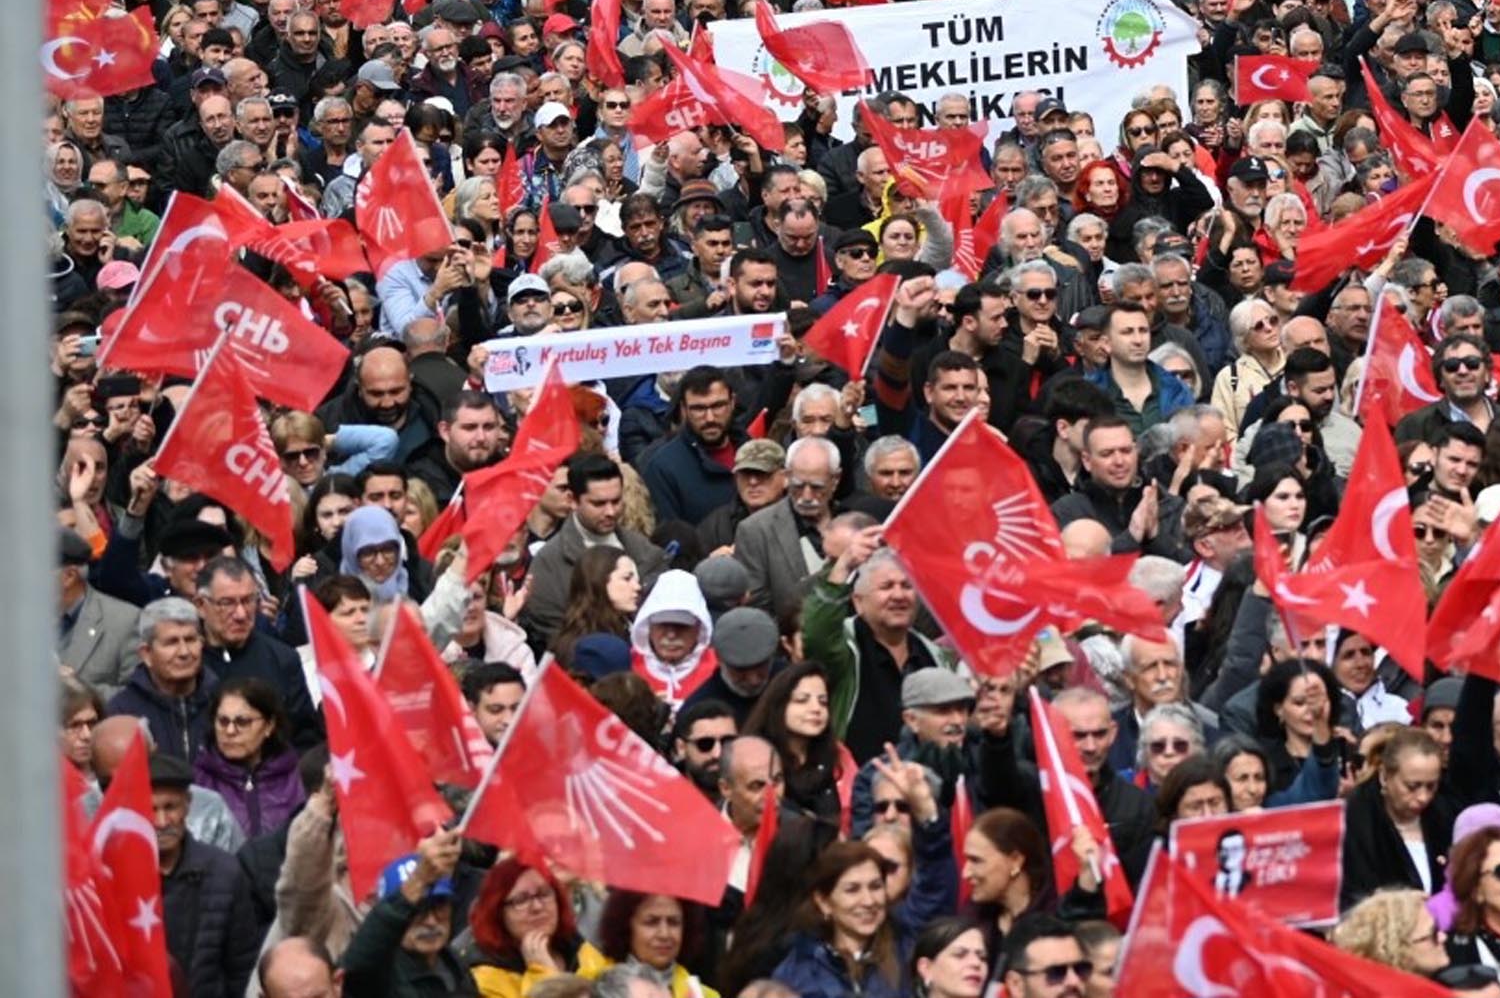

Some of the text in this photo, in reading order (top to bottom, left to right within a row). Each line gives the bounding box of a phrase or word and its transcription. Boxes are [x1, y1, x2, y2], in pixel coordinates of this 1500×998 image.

[922, 13, 1005, 48] TÜM
[842, 42, 1088, 97] MEKLİLERİN
[613, 338, 641, 358] Yok
[648, 336, 673, 354] Tek
[679, 333, 731, 352] Başına
